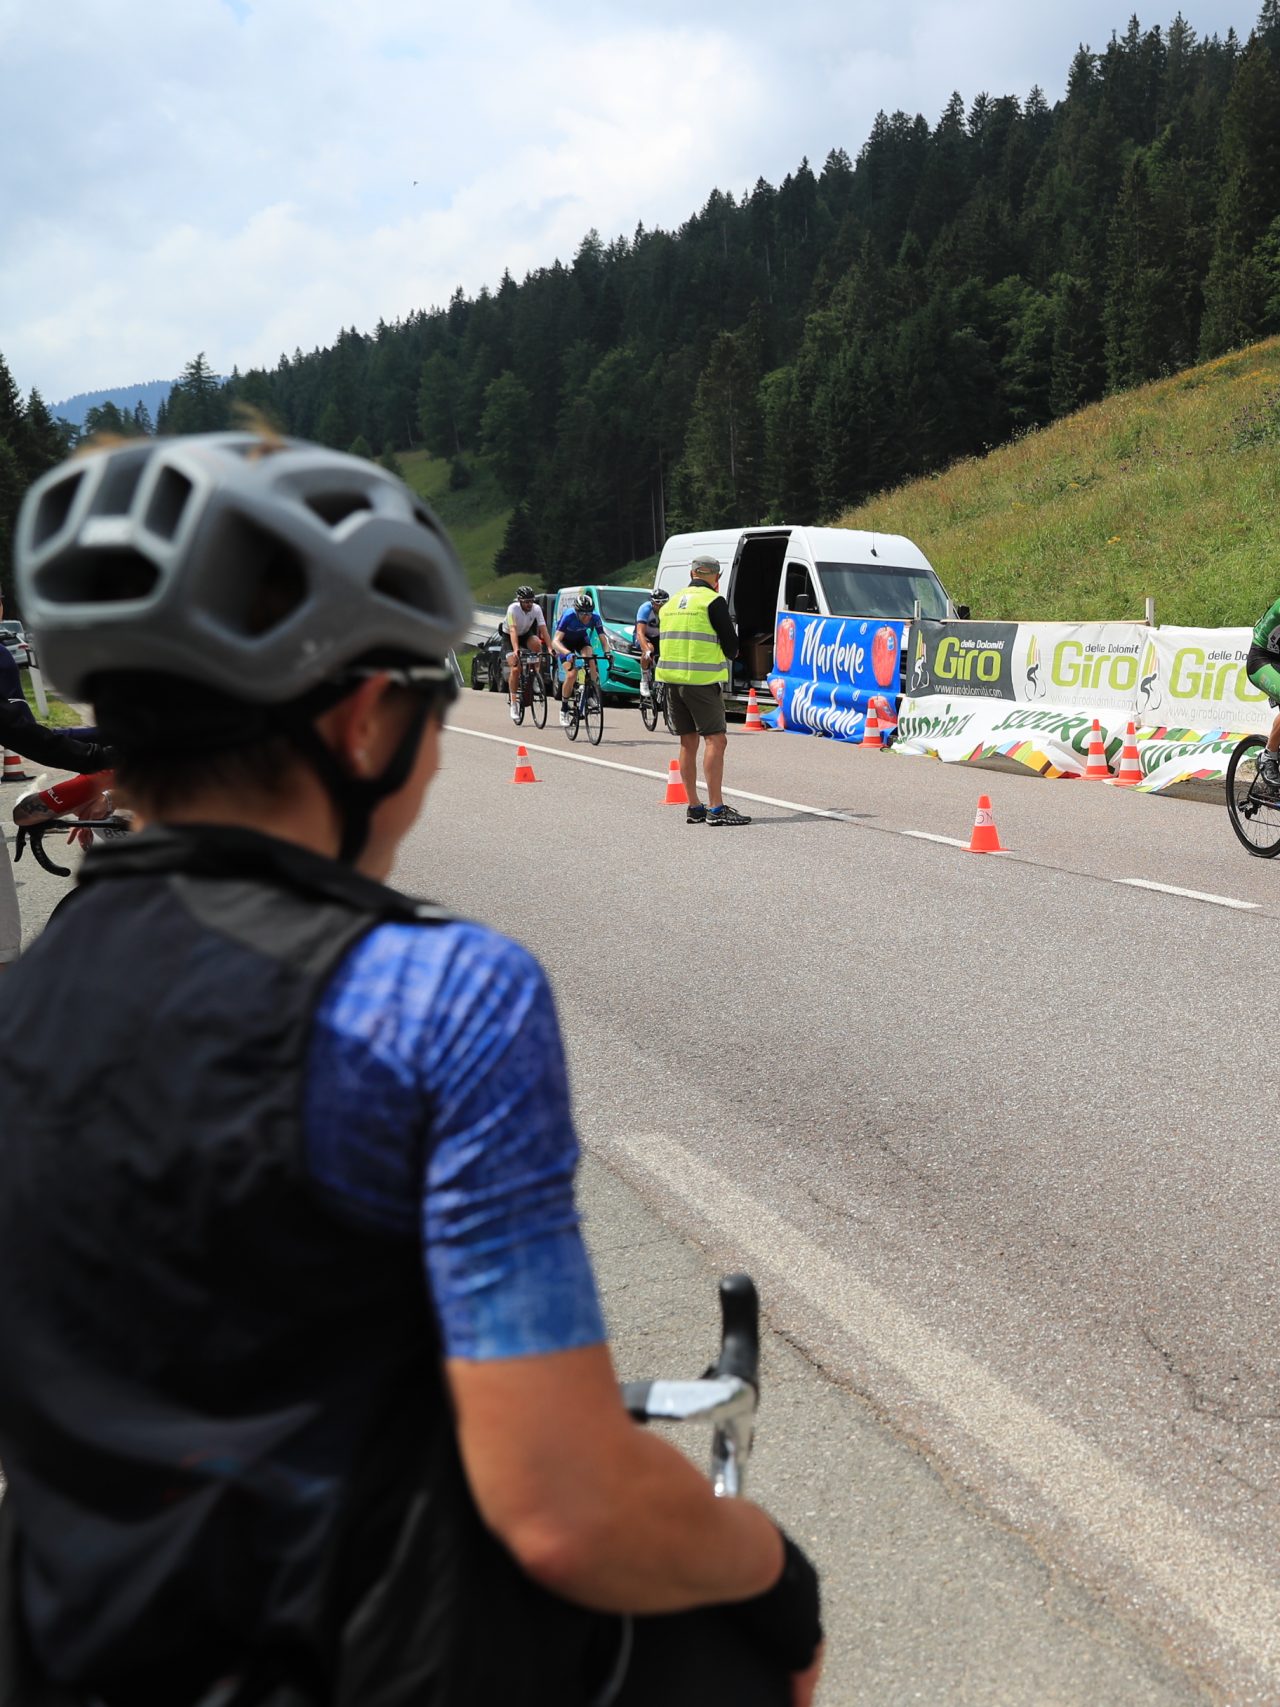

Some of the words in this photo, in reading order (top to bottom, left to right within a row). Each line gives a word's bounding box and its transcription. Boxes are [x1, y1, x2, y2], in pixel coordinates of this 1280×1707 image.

[801, 618, 864, 684] Marlene
[934, 636, 1002, 682] Giro
[1051, 640, 1139, 691] Giro
[1085, 643, 1106, 653] delle
[1108, 643, 1140, 654] Dolomit
[1207, 650, 1232, 661] delle
[790, 681, 864, 740] Marlene
